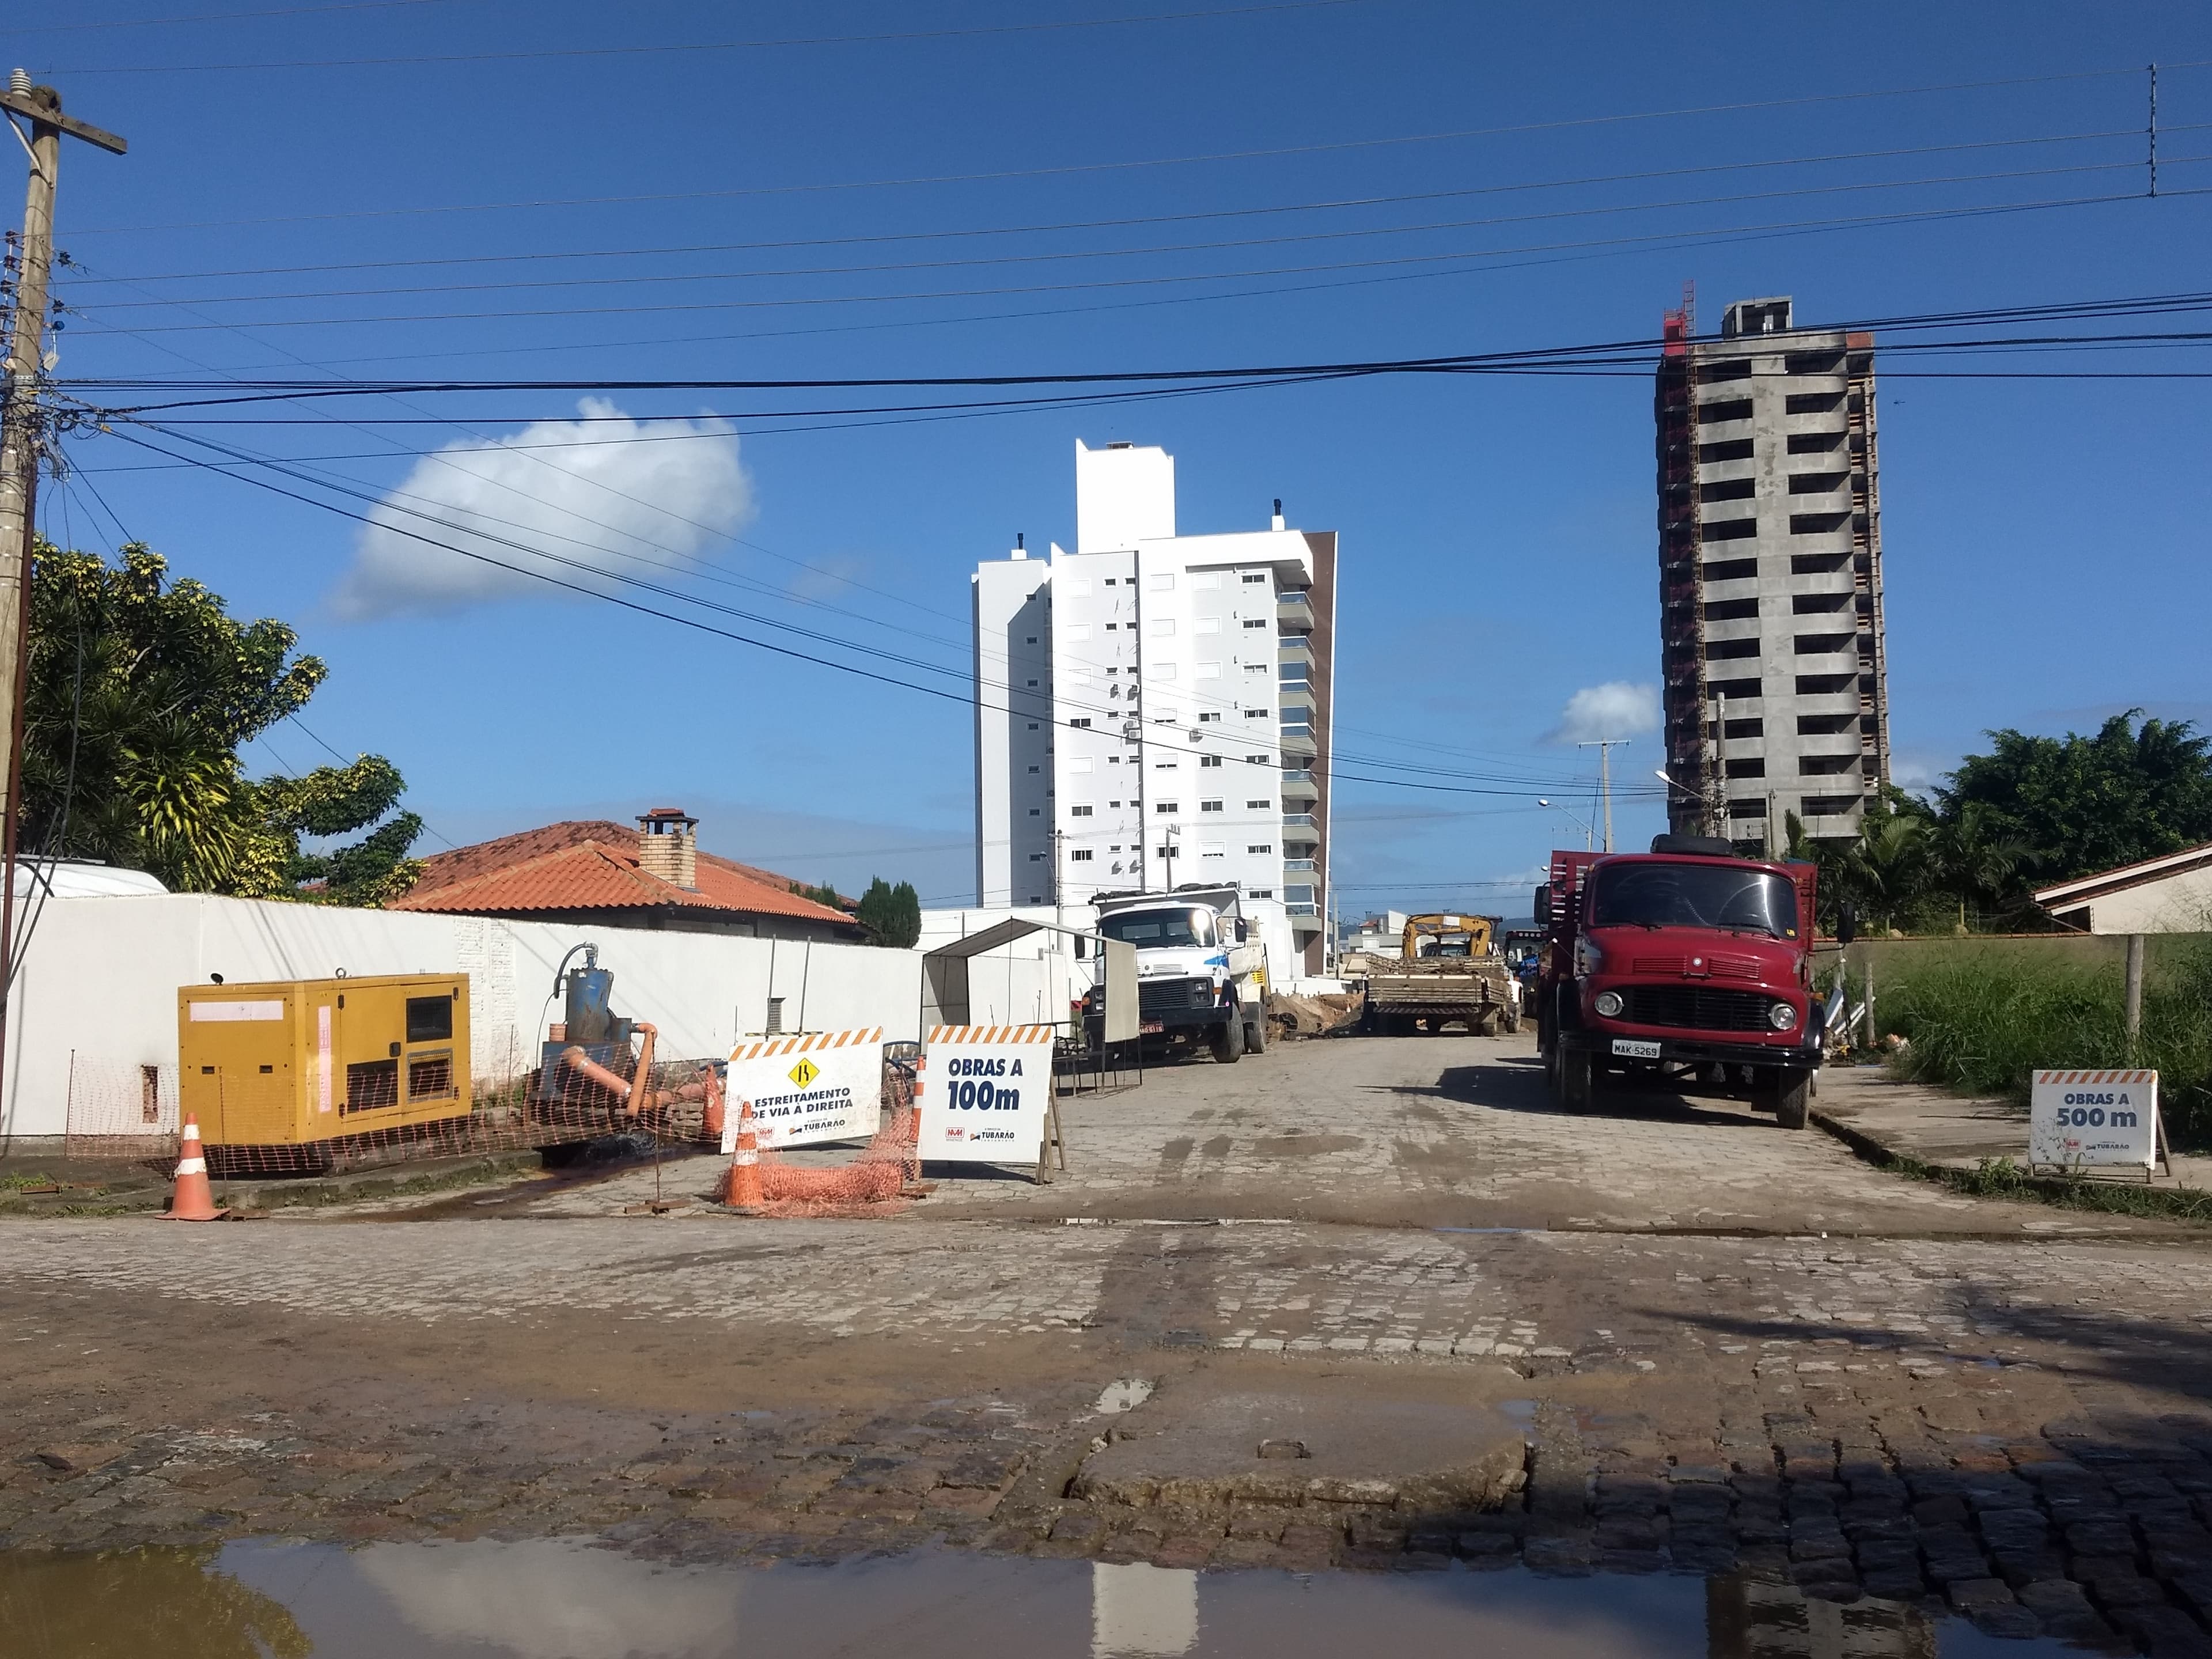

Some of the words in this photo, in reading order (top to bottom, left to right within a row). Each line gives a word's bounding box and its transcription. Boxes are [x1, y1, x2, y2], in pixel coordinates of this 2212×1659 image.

[1615, 1045, 1631, 1054] MAK
[1635, 1047, 1657, 1056] 5269
[948, 1059, 1006, 1077] OBRAS
[1010, 1059, 1023, 1076] A
[755, 1088, 850, 1108] ESTREITAMENTO
[948, 1081, 1020, 1110] 100m
[2065, 1093, 2114, 1104] OBRAS
[2118, 1093, 2129, 1104] A
[752, 1110, 765, 1119] DE
[770, 1107, 790, 1118] VIA
[794, 1103, 802, 1114] À
[806, 1099, 853, 1113] DIREITA
[2057, 1108, 2105, 1127] 500
[2110, 1112, 2137, 1127] m
[804, 1118, 846, 1130] TUBARÃO
[982, 1130, 1014, 1139] TUBARÃO
